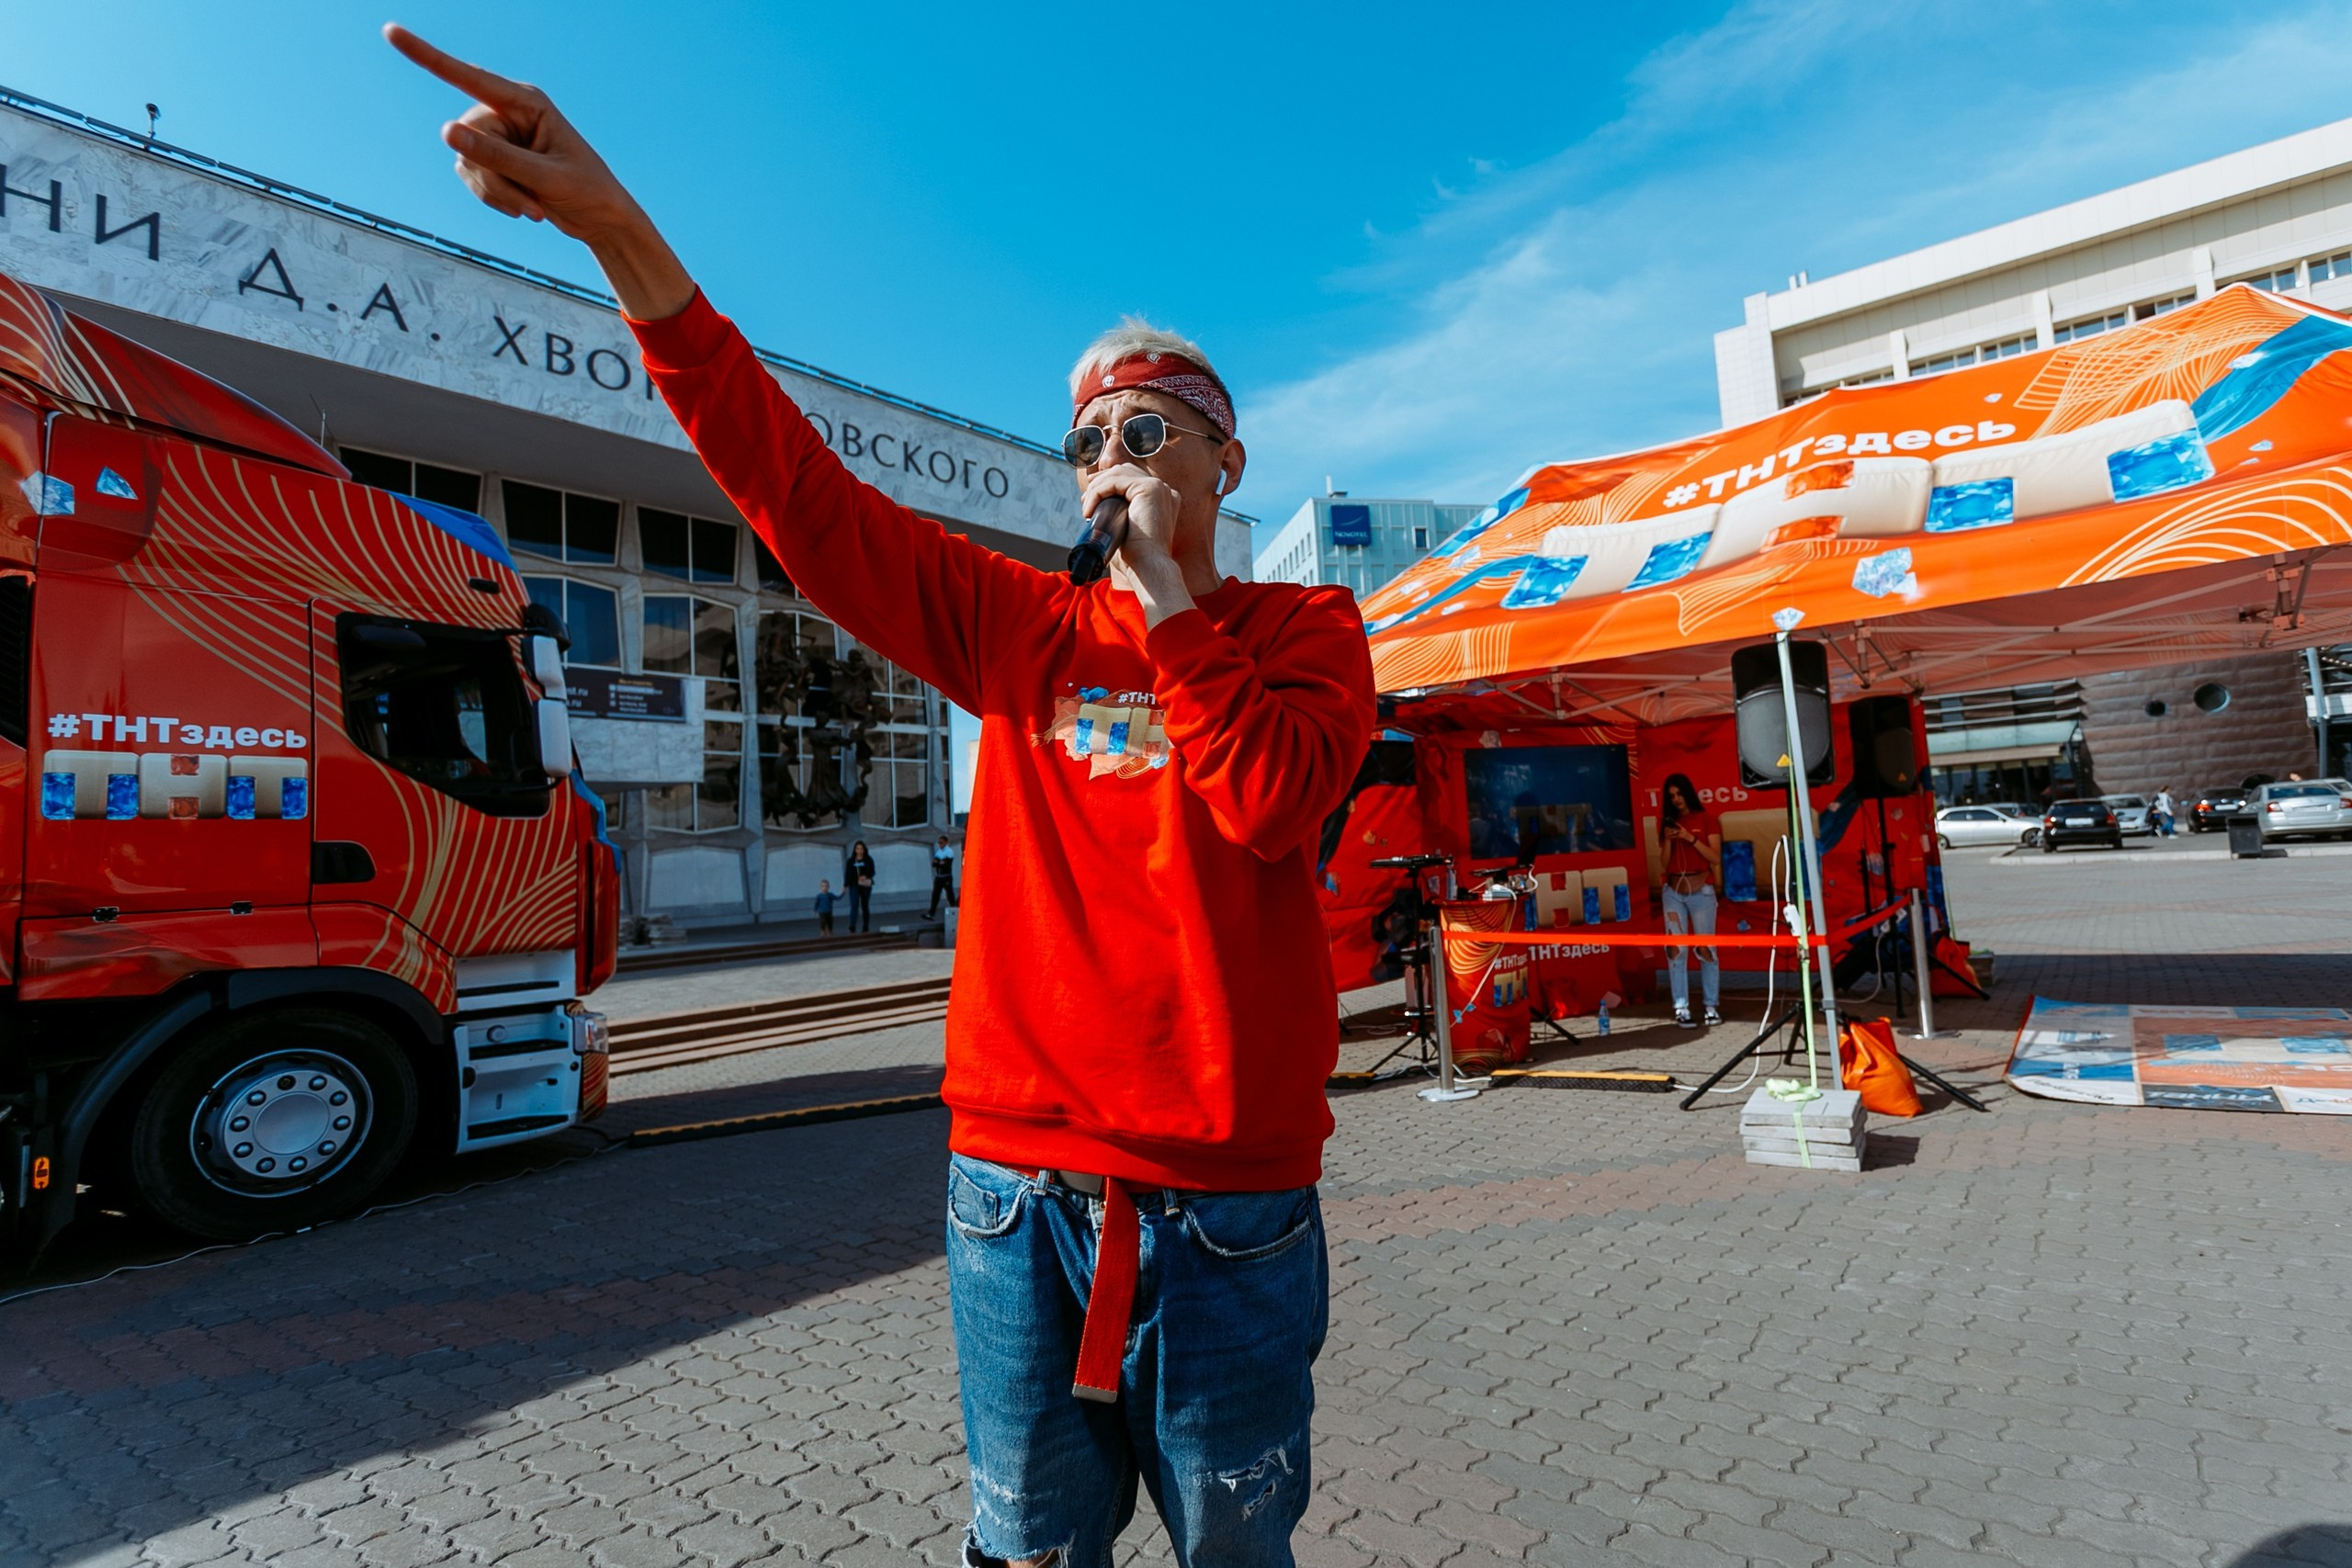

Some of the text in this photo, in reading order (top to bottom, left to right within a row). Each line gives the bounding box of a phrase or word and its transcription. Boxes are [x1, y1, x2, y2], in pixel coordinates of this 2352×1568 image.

[1664, 418, 2016, 508] #ТНТздесь
[48, 713, 308, 749] #ТНТздесь
[41, 749, 309, 820] ТНТ
